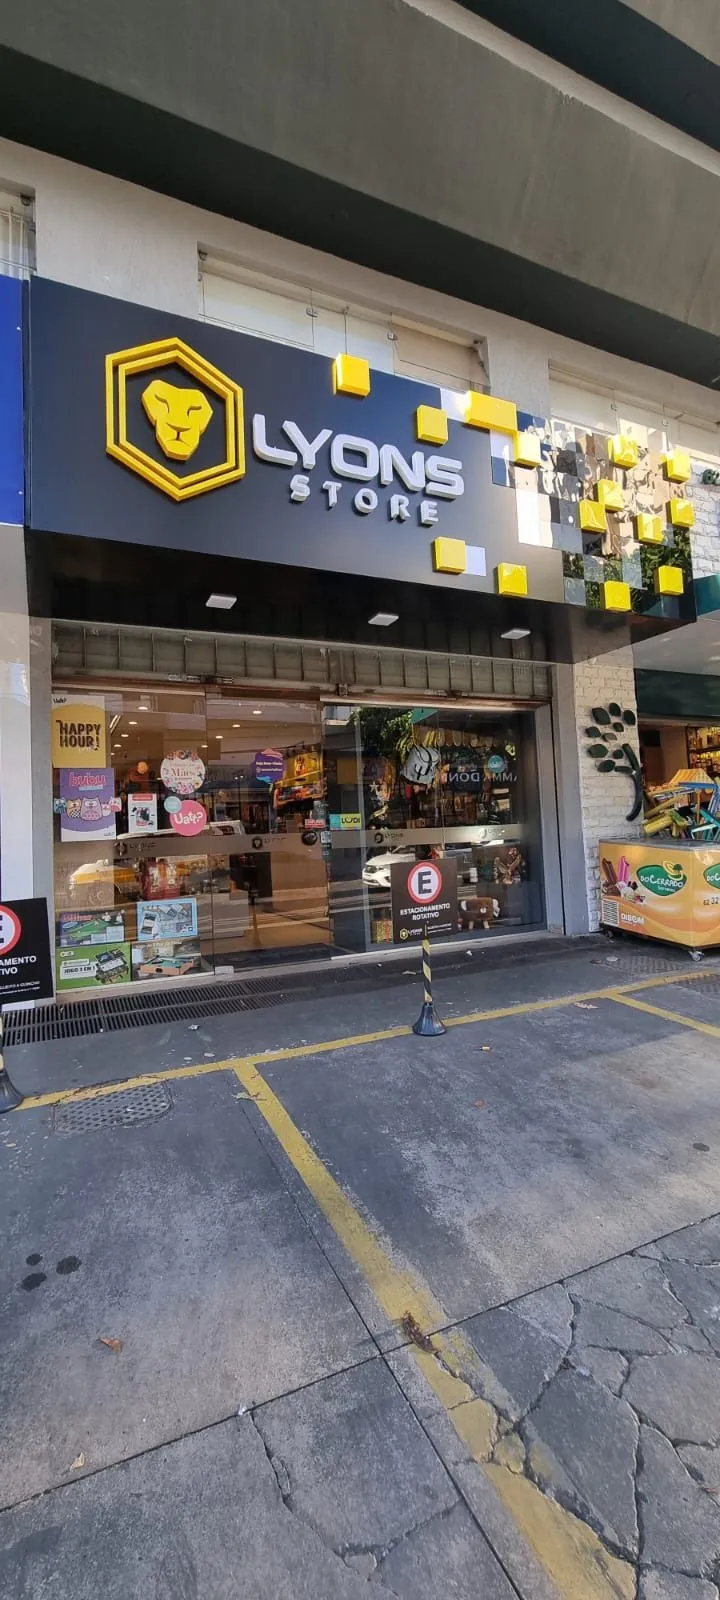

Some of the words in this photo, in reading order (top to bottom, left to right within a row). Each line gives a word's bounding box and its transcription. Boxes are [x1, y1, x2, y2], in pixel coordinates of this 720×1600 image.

[252, 413, 465, 500] LYONS
[289, 473, 440, 527] STORE
[56, 720, 101, 736] HAPPY
[59, 735, 100, 751] HOUR!
[418, 870, 433, 895] E
[400, 903, 451, 916] ESTACIONAMENTO
[412, 911, 440, 921] ROTATIVO
